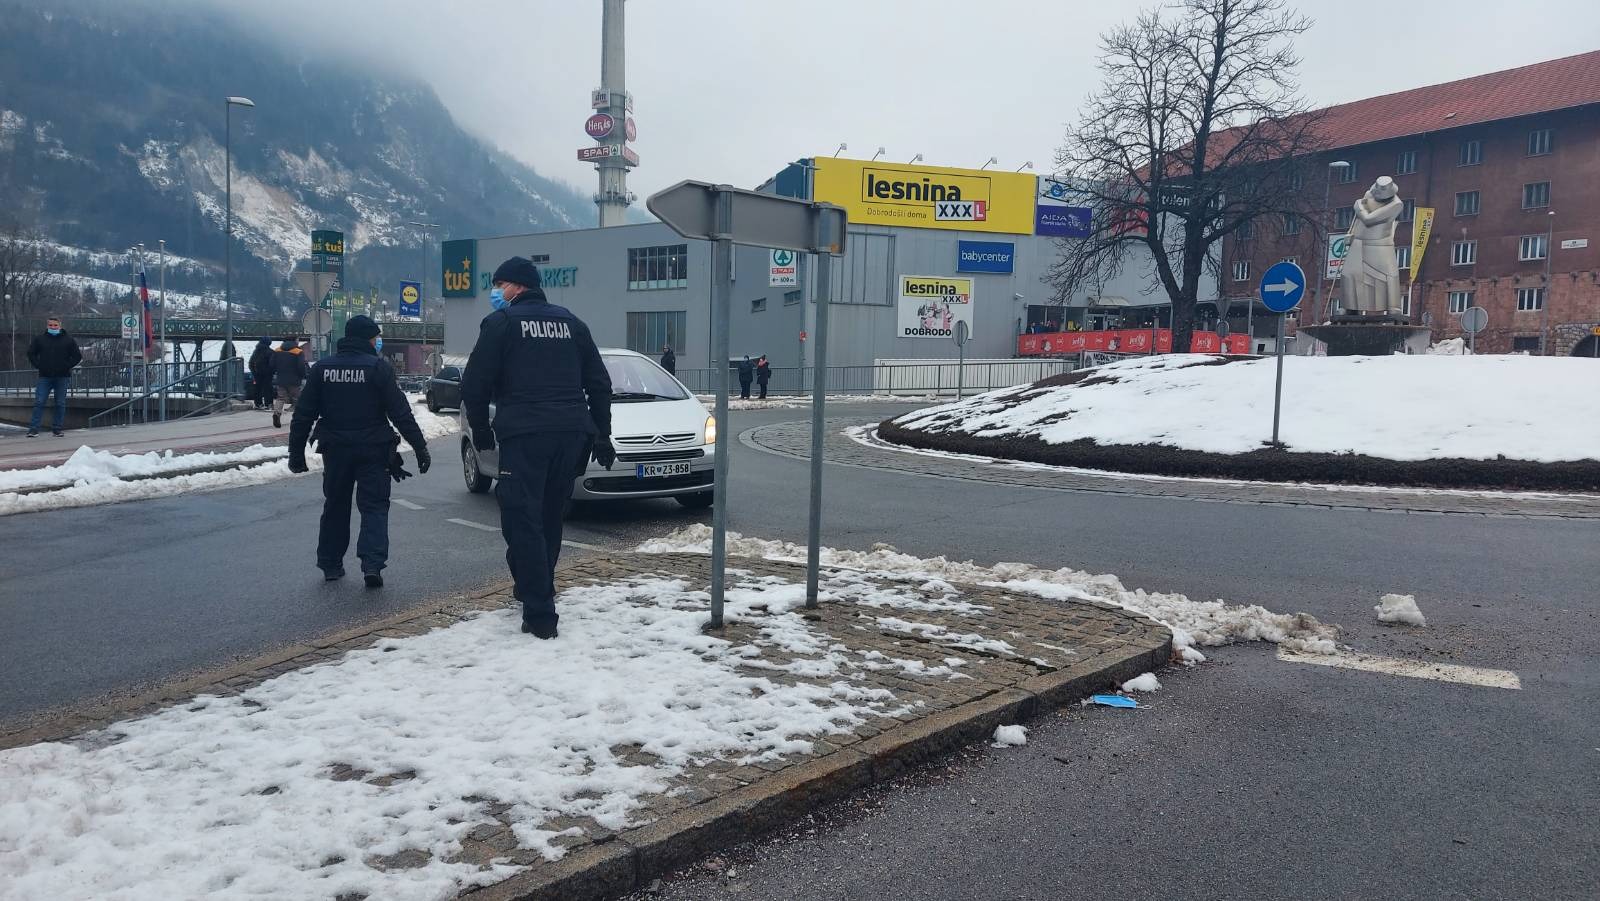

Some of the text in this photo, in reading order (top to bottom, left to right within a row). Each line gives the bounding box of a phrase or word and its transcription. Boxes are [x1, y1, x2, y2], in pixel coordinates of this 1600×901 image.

[583, 148, 609, 157] SPAR
[867, 174, 961, 202] lesnina
[907, 210, 927, 219] doma
[938, 203, 984, 218] XXXL
[961, 250, 1010, 263] babycenter
[905, 280, 957, 295] lesnina
[942, 293, 968, 304] XXXL
[520, 320, 571, 339] POLICIJA
[904, 327, 952, 337] DOBRODO
[323, 369, 365, 383] POLICIJA
[644, 463, 689, 476] KR Z3-858
